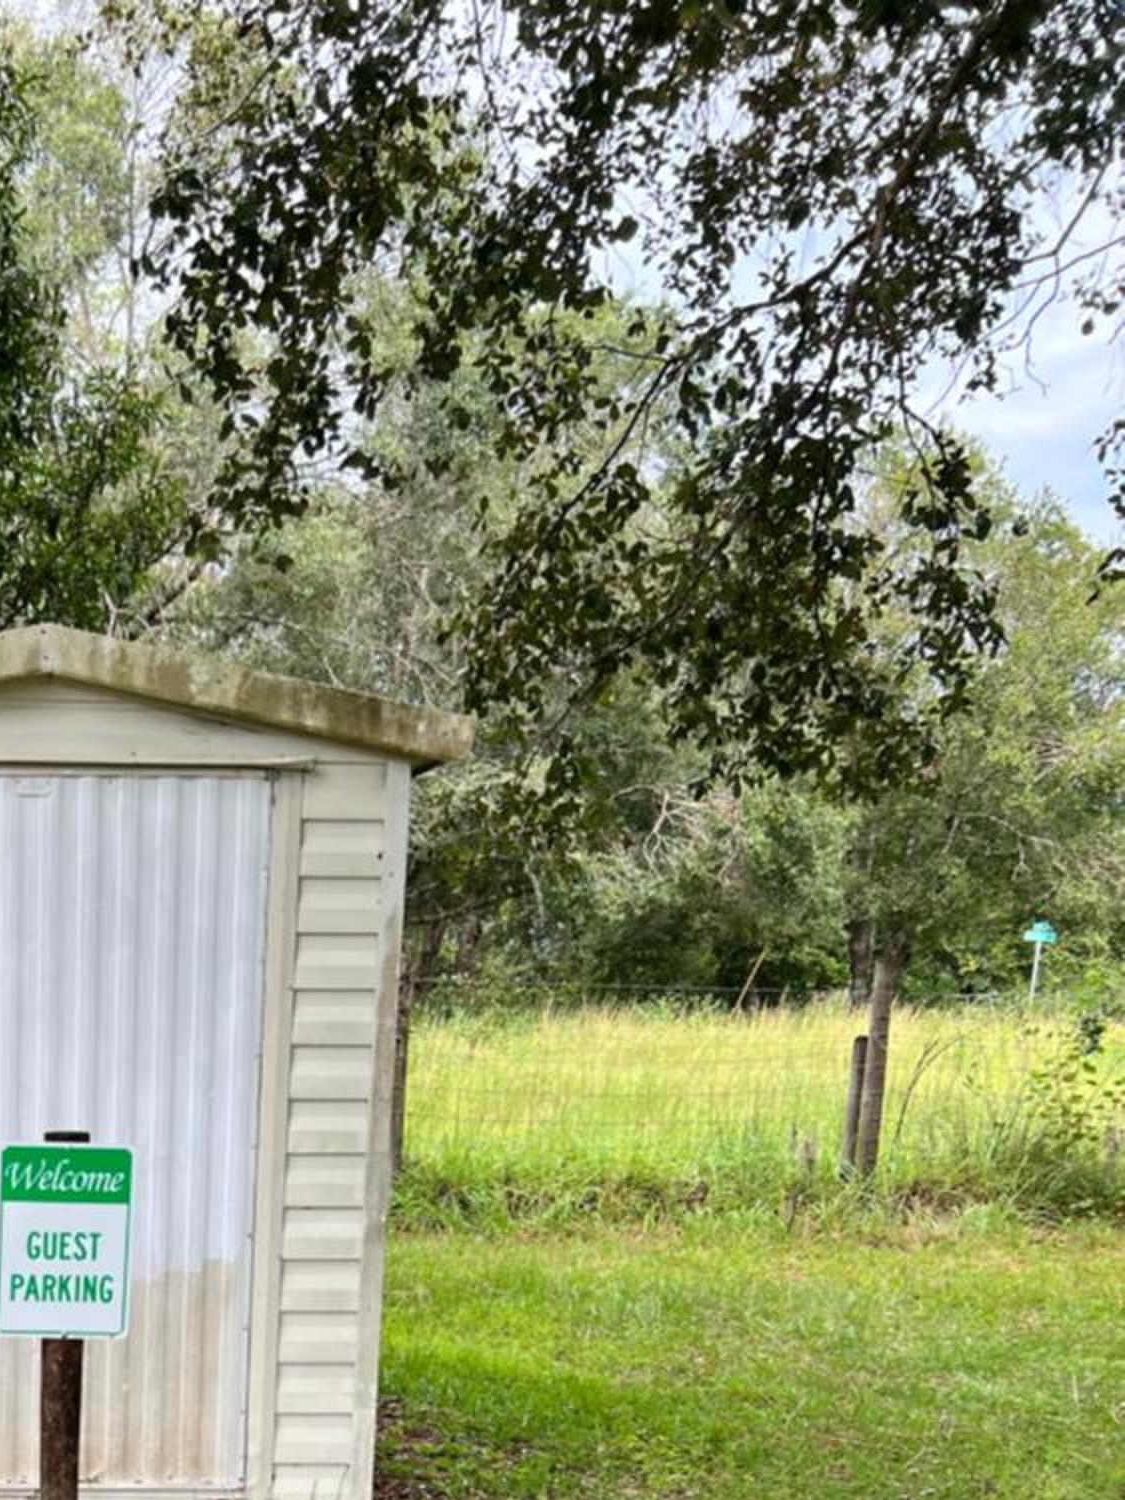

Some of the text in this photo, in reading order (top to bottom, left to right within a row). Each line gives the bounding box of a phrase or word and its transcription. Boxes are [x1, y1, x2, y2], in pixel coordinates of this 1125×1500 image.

[4, 1159, 124, 1192] Welcome
[27, 1231, 102, 1261] GUEST
[10, 1273, 114, 1304] PARKING
